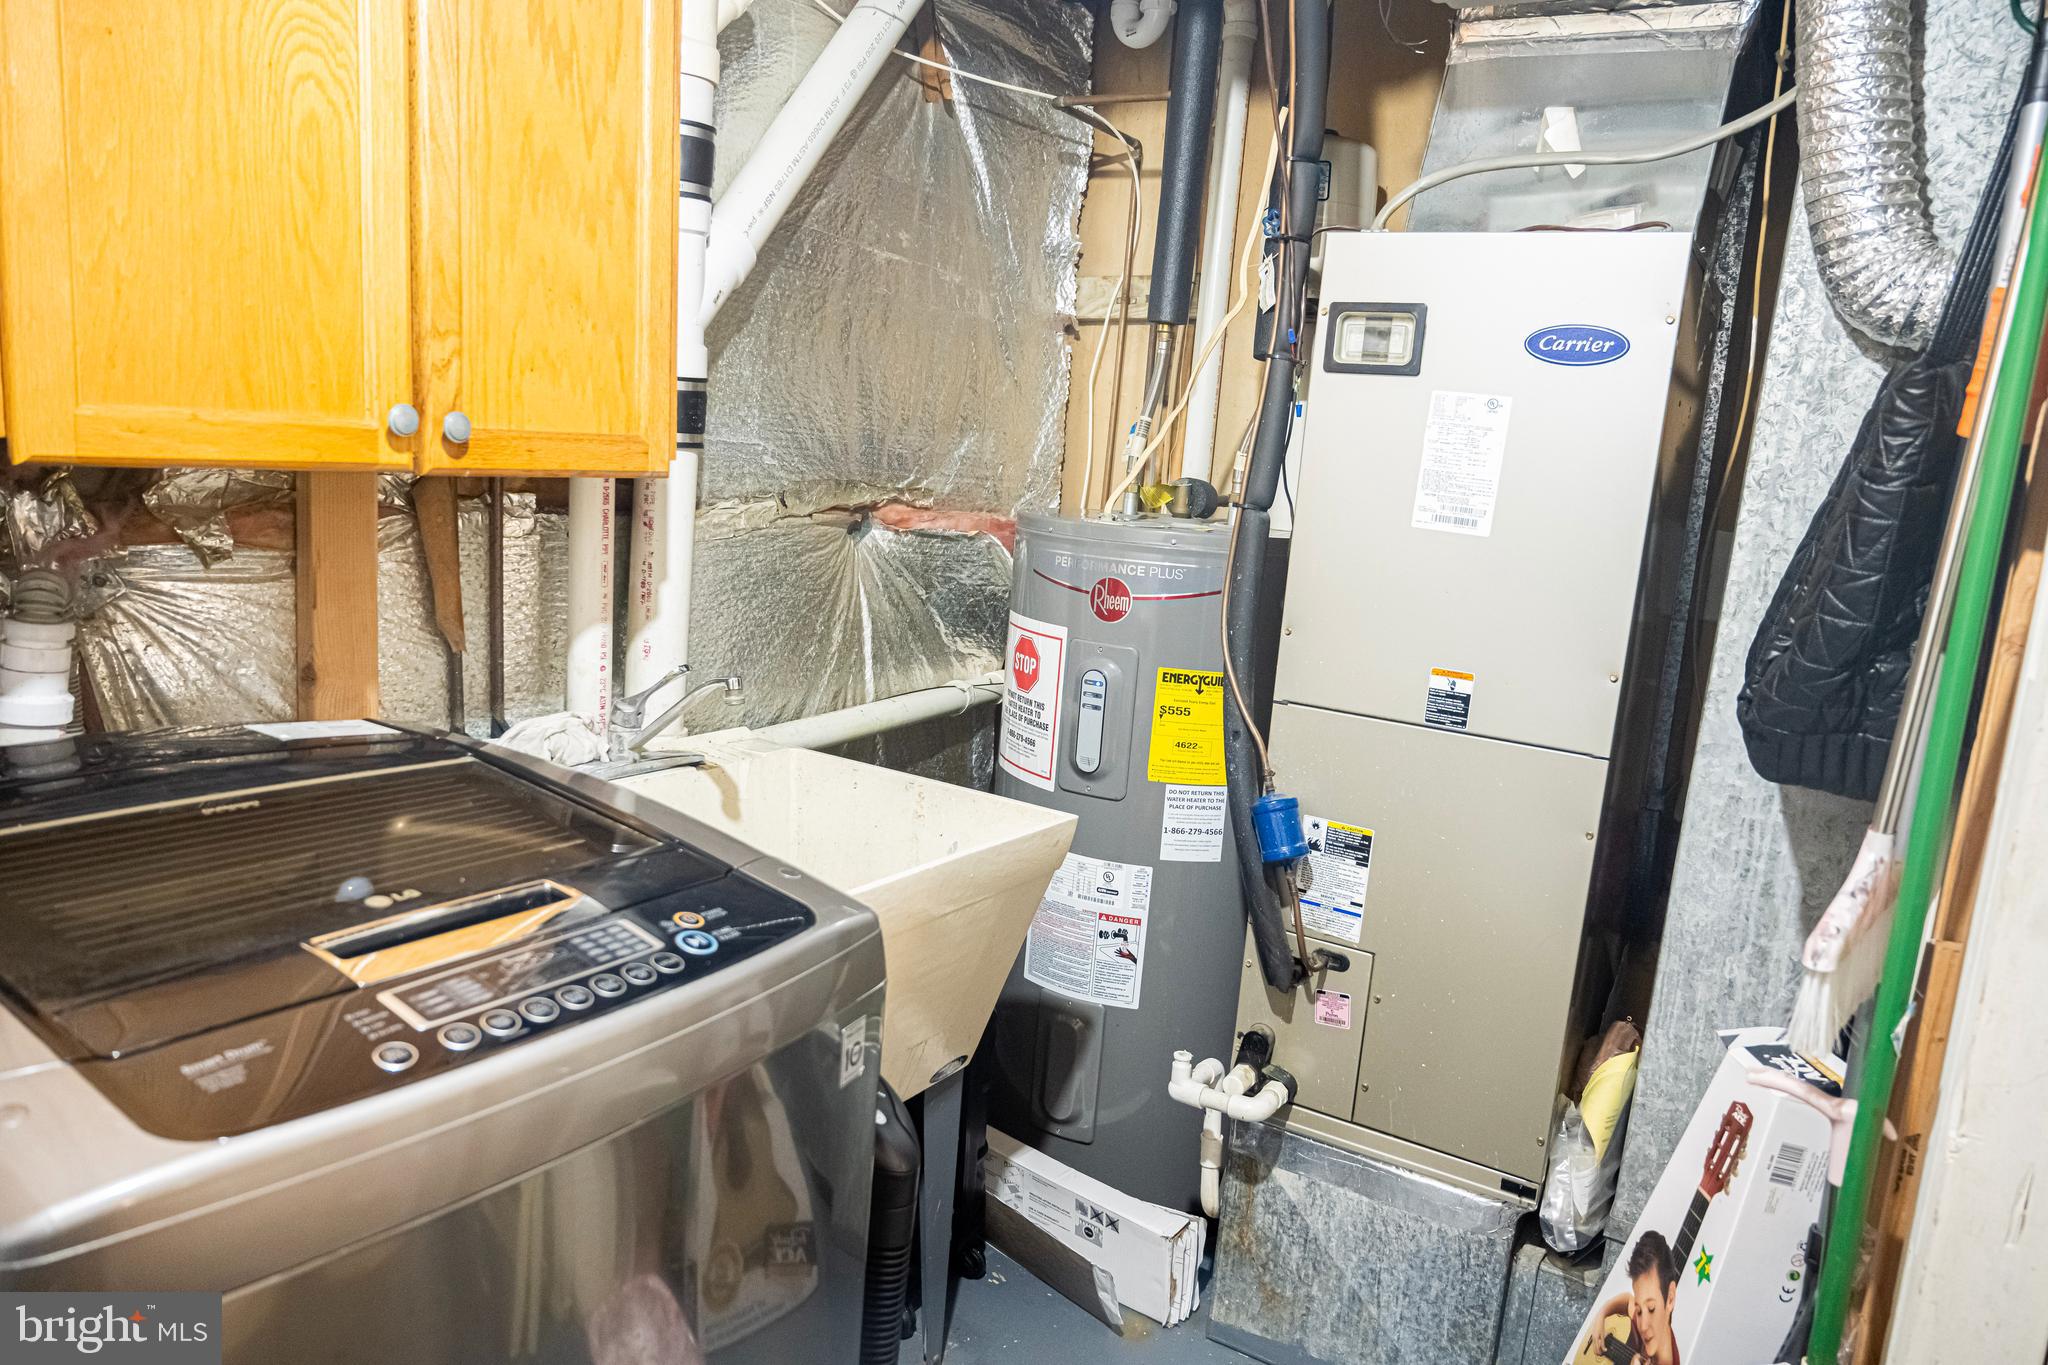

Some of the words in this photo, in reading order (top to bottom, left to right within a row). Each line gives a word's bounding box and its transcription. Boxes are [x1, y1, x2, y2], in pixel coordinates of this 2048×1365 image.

[1539, 335, 1614, 354] Carrier
[601, 508, 609, 541] CHARLOTTE
[1055, 556, 1145, 576] PERFORMANCE
[1149, 566, 1184, 580] PLUS
[1094, 578, 1130, 615] Rheem
[1015, 652, 1037, 675] STOP
[1017, 692, 1034, 708] RETURN
[1034, 701, 1046, 711] THIS
[1160, 705, 1191, 717] $555
[1018, 704, 1034, 718] HEATER
[1034, 708, 1042, 720] TO
[1018, 713, 1024, 724] OF
[1024, 715, 1049, 732] PURCHASE
[1175, 741, 1198, 750] 4622
[1164, 826, 1222, 836] 1-866-279-4566
[1108, 916, 1139, 925] DANGER
